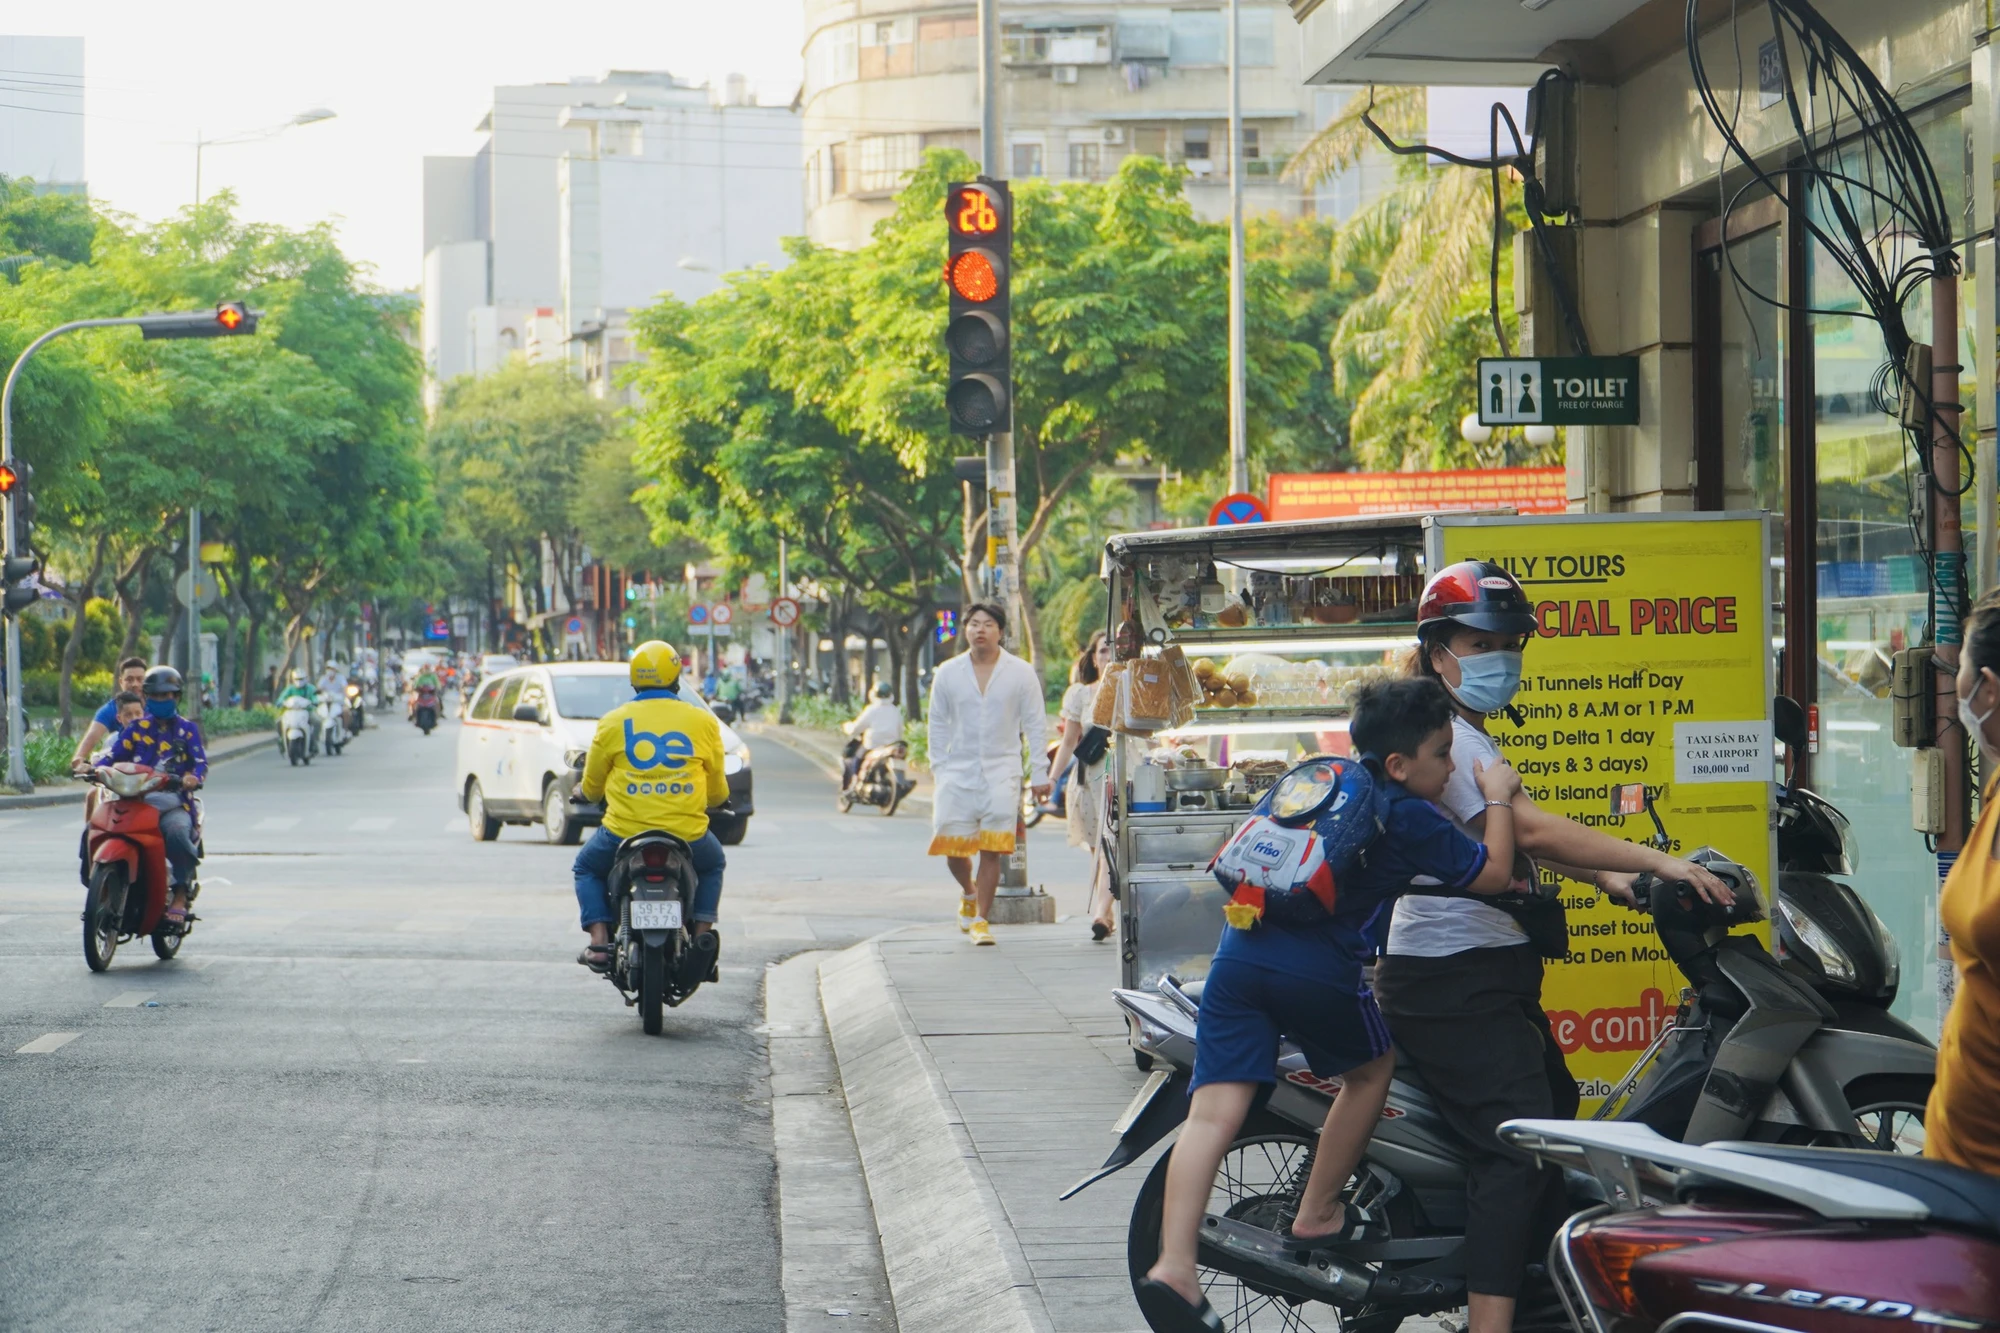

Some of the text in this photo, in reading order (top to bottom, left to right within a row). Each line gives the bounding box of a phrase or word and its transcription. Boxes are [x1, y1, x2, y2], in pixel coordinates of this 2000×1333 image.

[959, 192, 997, 231] 26
[1553, 378, 1628, 398] TOILET
[1558, 401, 1624, 409] FREE OF CHARGE
[1545, 555, 1625, 578] TOURS
[1521, 596, 1738, 639] CIAL PRICE
[1537, 675, 1603, 691] Tunnels
[1649, 673, 1684, 690] Day
[1568, 703, 1579, 718] 8
[1624, 704, 1643, 716] or
[1648, 700, 1655, 715] 1
[624, 718, 694, 770] be
[1493, 728, 1655, 750] ekong Delta 1 day
[1686, 732, 1760, 744] TAXI SÂN BAY
[1686, 749, 1760, 759] CAR AIRPORT
[1517, 758, 1560, 776] days
[1565, 757, 1578, 773] &
[1583, 756, 1593, 772] 3
[1599, 756, 1649, 774] days)
[1731, 763, 1750, 773] vnd
[1555, 784, 1608, 800] Island
[1253, 842, 1281, 858] Friso
[1559, 895, 1596, 910] uise
[1563, 949, 1586, 965] Ba
[1591, 948, 1627, 963] Den
[1631, 946, 1670, 962] Mou
[1590, 997, 1677, 1043] cont
[1577, 1080, 1611, 1097] Zalo
[1737, 1282, 1914, 1318] LEAD
